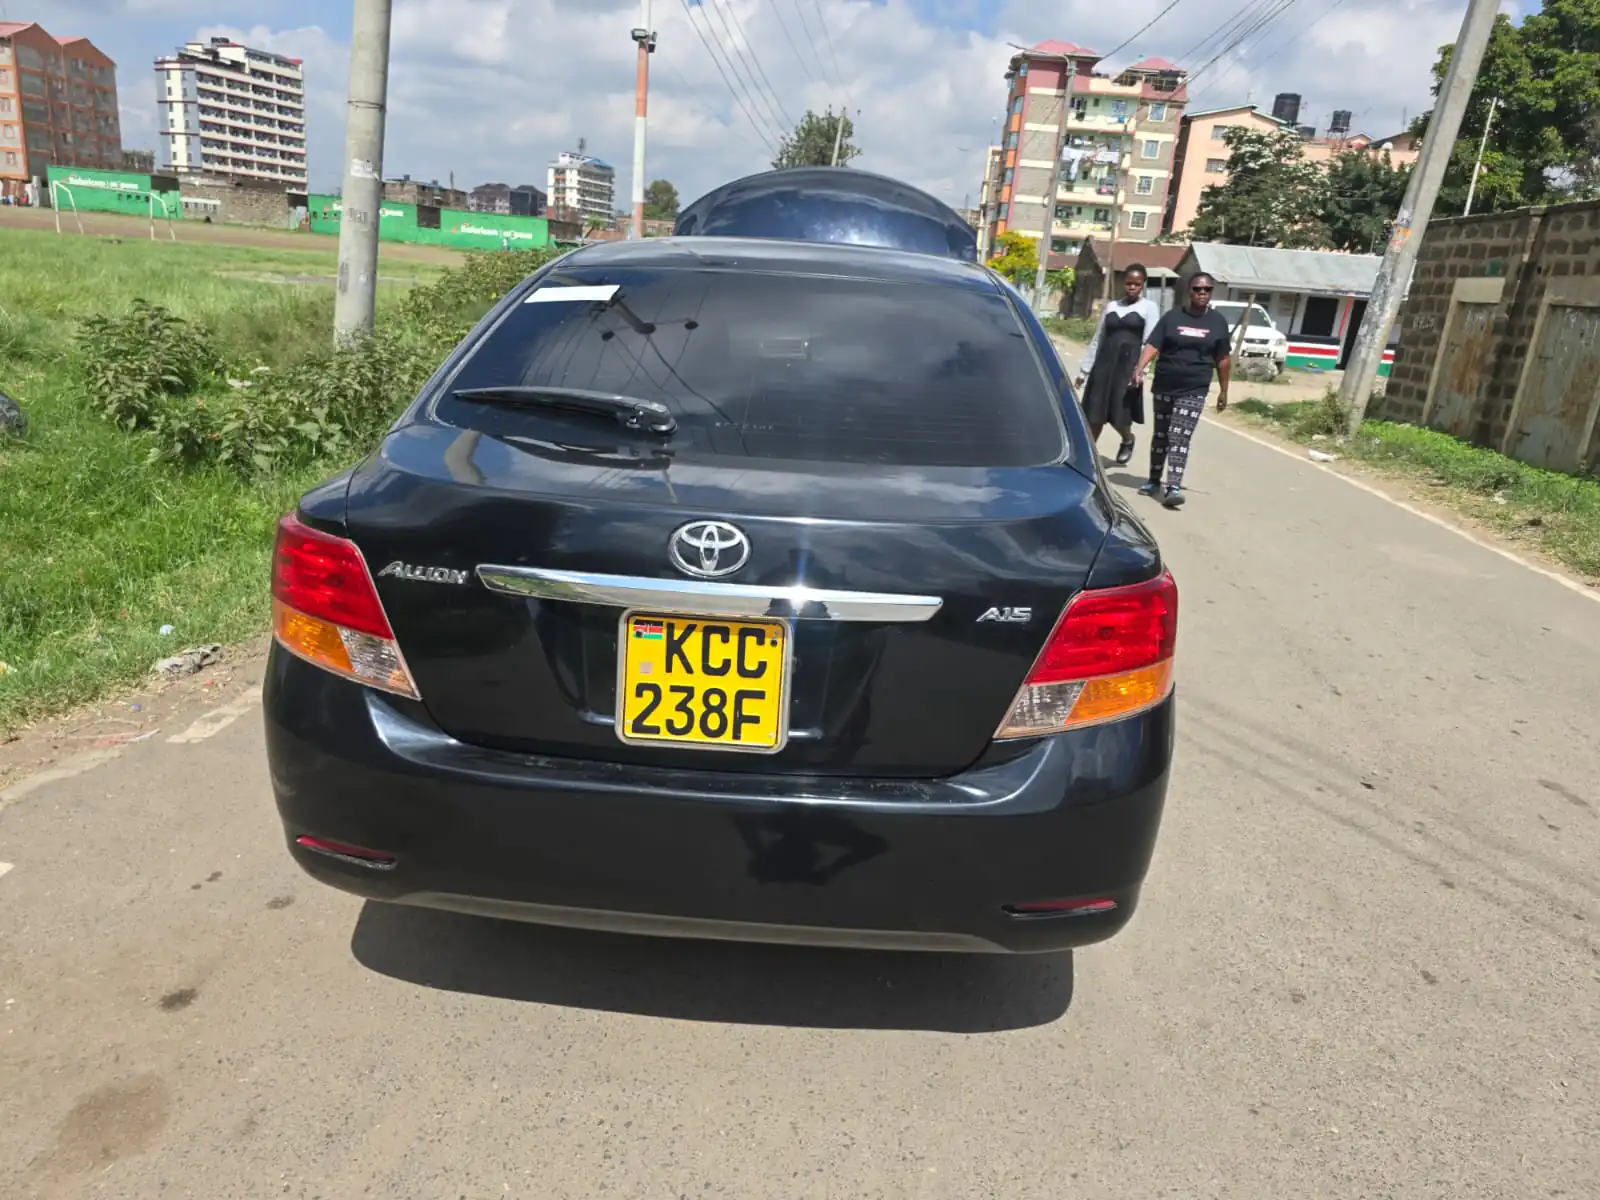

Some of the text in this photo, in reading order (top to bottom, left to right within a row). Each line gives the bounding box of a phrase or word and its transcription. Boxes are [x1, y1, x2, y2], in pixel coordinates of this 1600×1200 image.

[377, 560, 469, 585] ALLION
[975, 606, 1032, 623] A15
[665, 622, 768, 678] KCC
[631, 682, 767, 740] 238F
